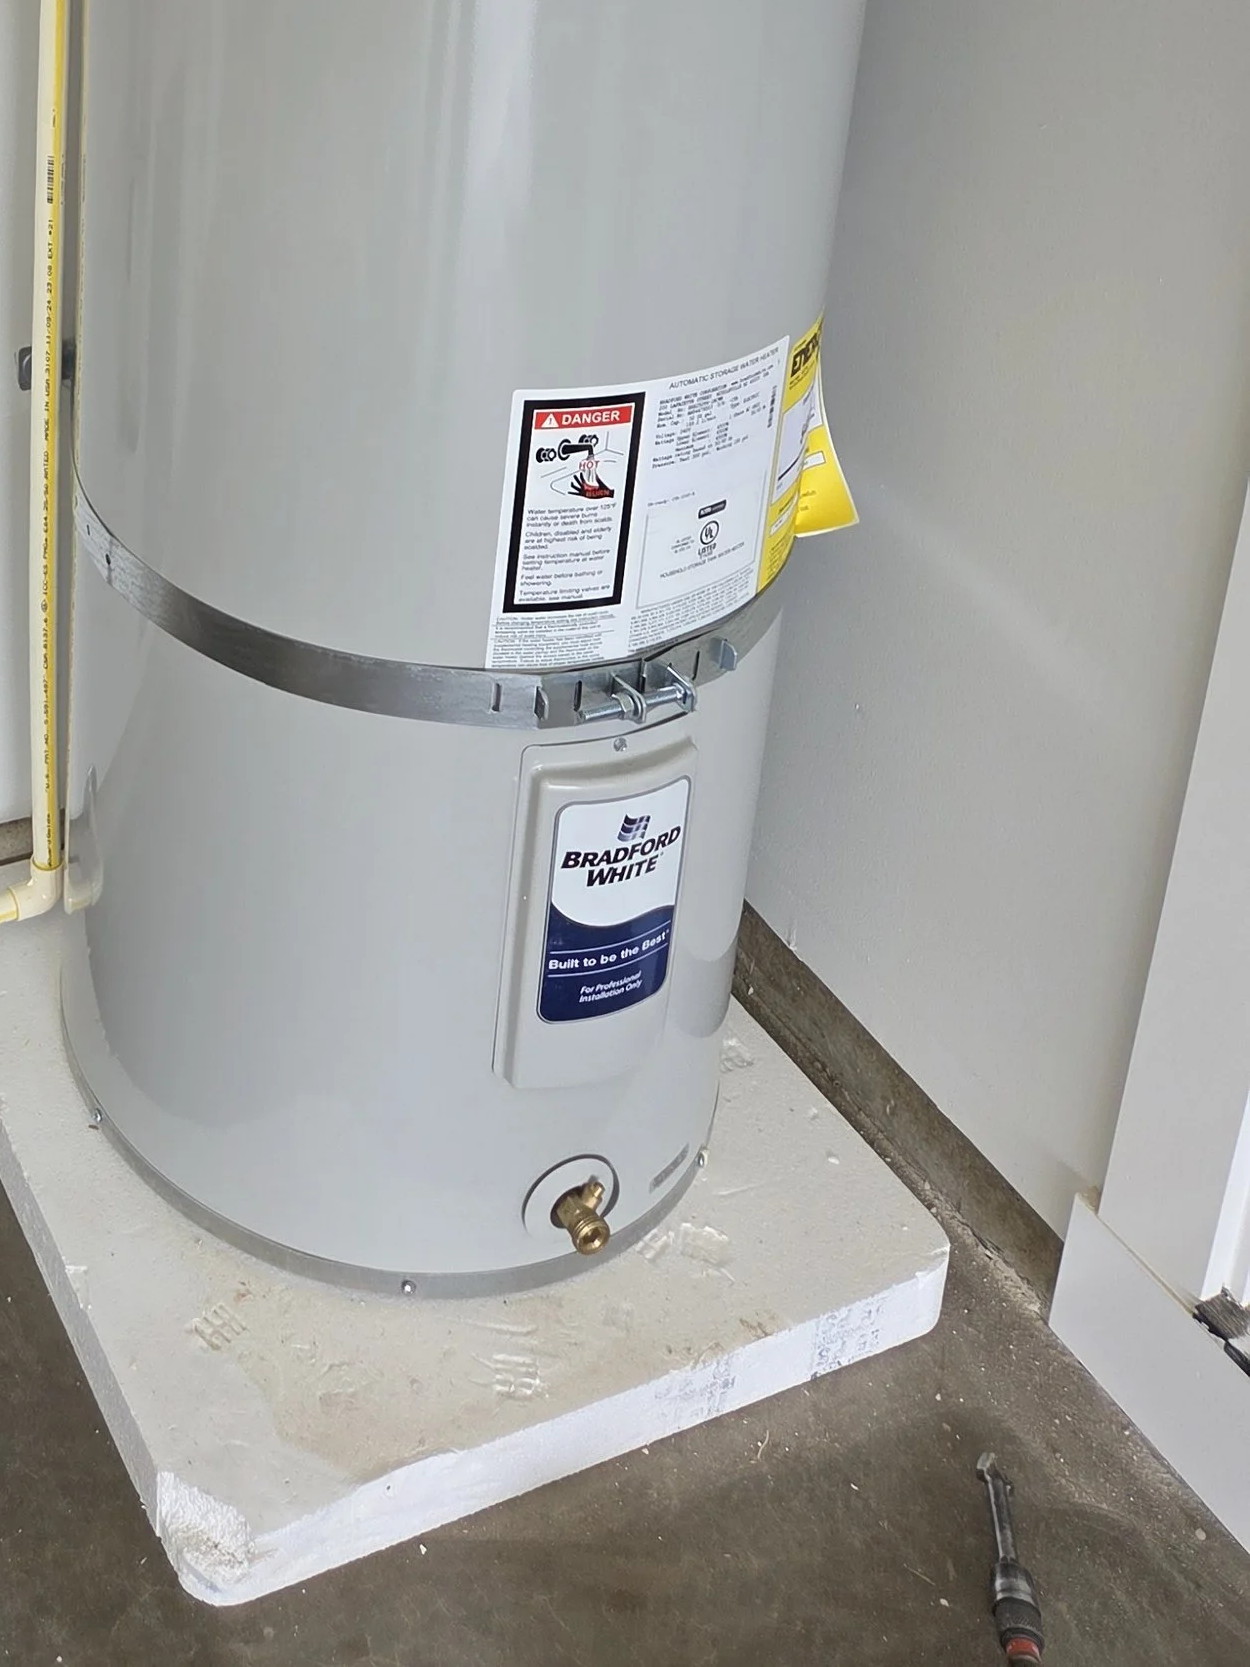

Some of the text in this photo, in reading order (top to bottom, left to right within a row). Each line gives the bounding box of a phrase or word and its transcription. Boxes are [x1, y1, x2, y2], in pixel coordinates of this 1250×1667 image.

[669, 374, 709, 389] AUTOMATIC
[710, 365, 739, 380] STORAGE
[740, 356, 759, 369] WATER
[760, 346, 779, 360] HEATER
[561, 410, 620, 425] DANGER
[579, 460, 600, 470] HOT
[585, 489, 610, 497] BURN
[544, 536, 566, 544] highest
[698, 543, 717, 555] LISTED
[561, 825, 681, 869] BRADFORD
[586, 854, 659, 887] WHITE
[549, 931, 666, 969] Built to be the Best
[578, 979, 643, 1003] Installation Only
[580, 970, 642, 994] For Professional
